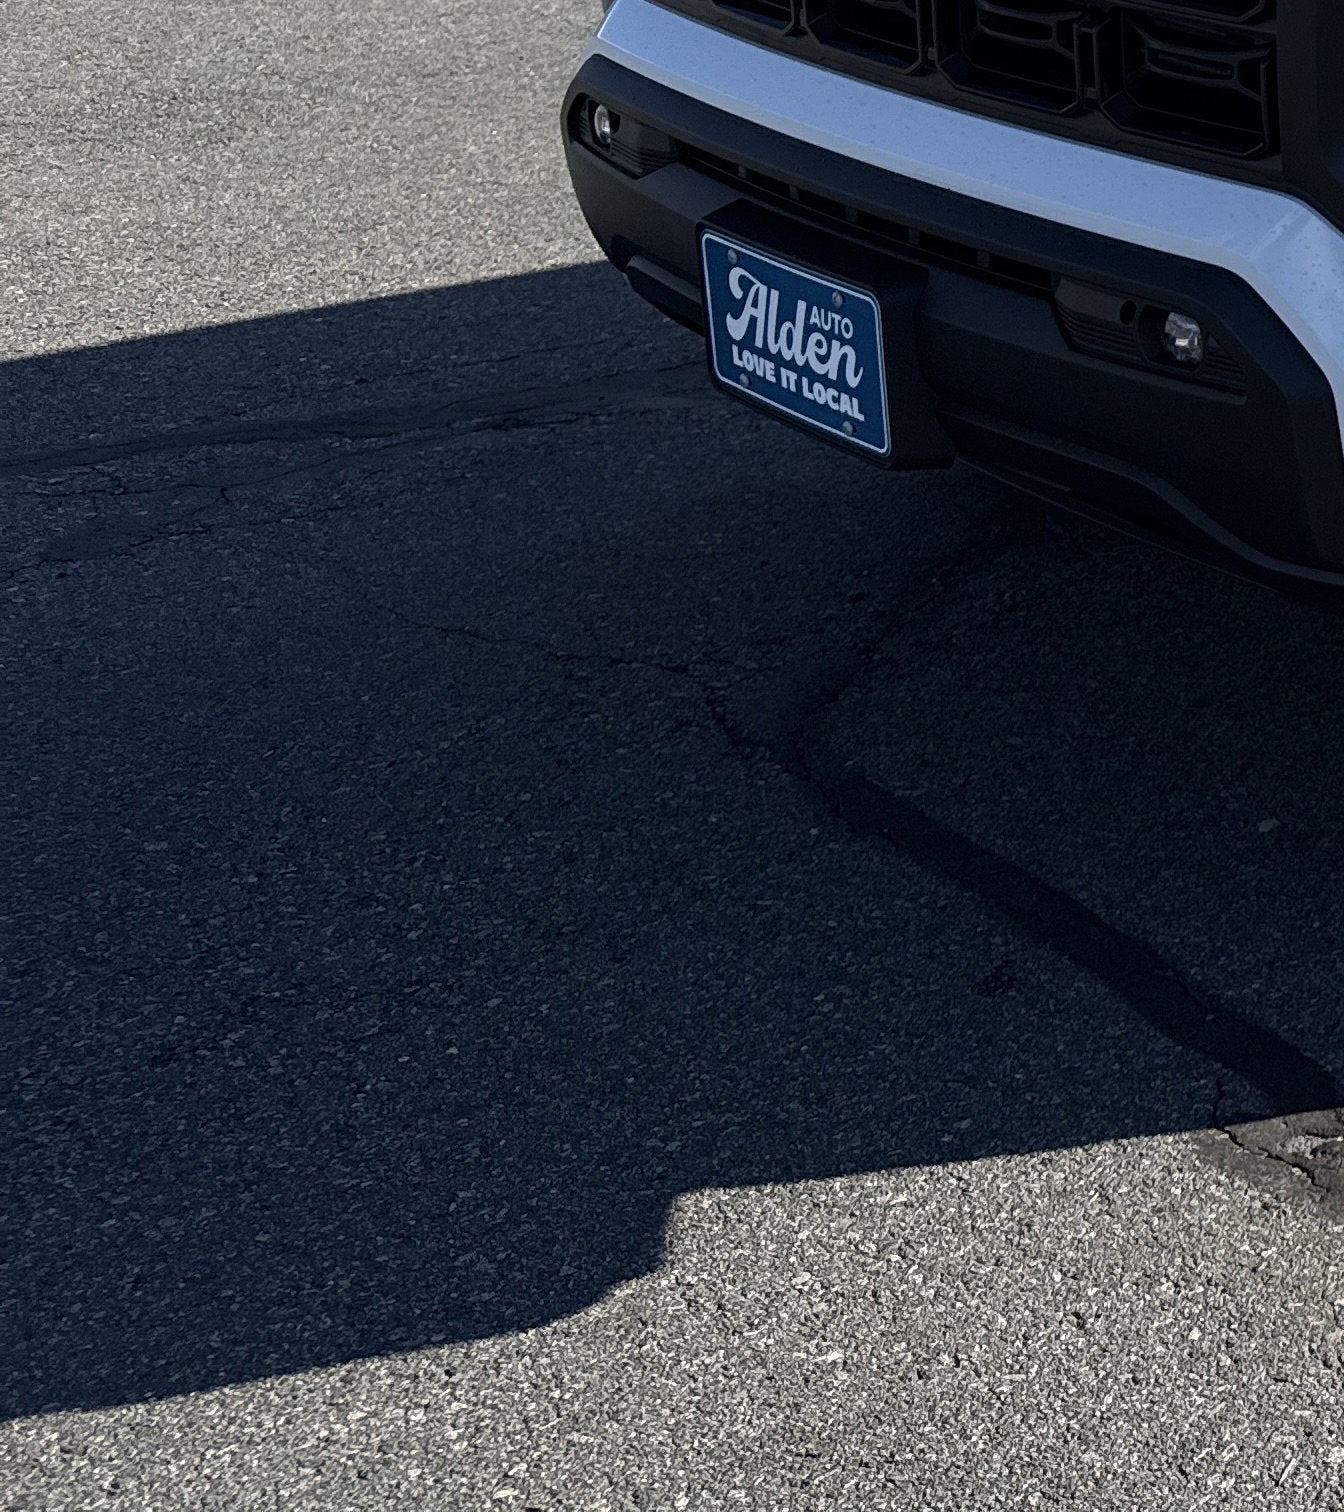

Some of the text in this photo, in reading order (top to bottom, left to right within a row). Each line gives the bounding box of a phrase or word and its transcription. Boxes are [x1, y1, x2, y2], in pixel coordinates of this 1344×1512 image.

[726, 266, 864, 388] Alden
[809, 305, 854, 339] AUTO
[732, 344, 865, 422] LOVE IT LOCAL
